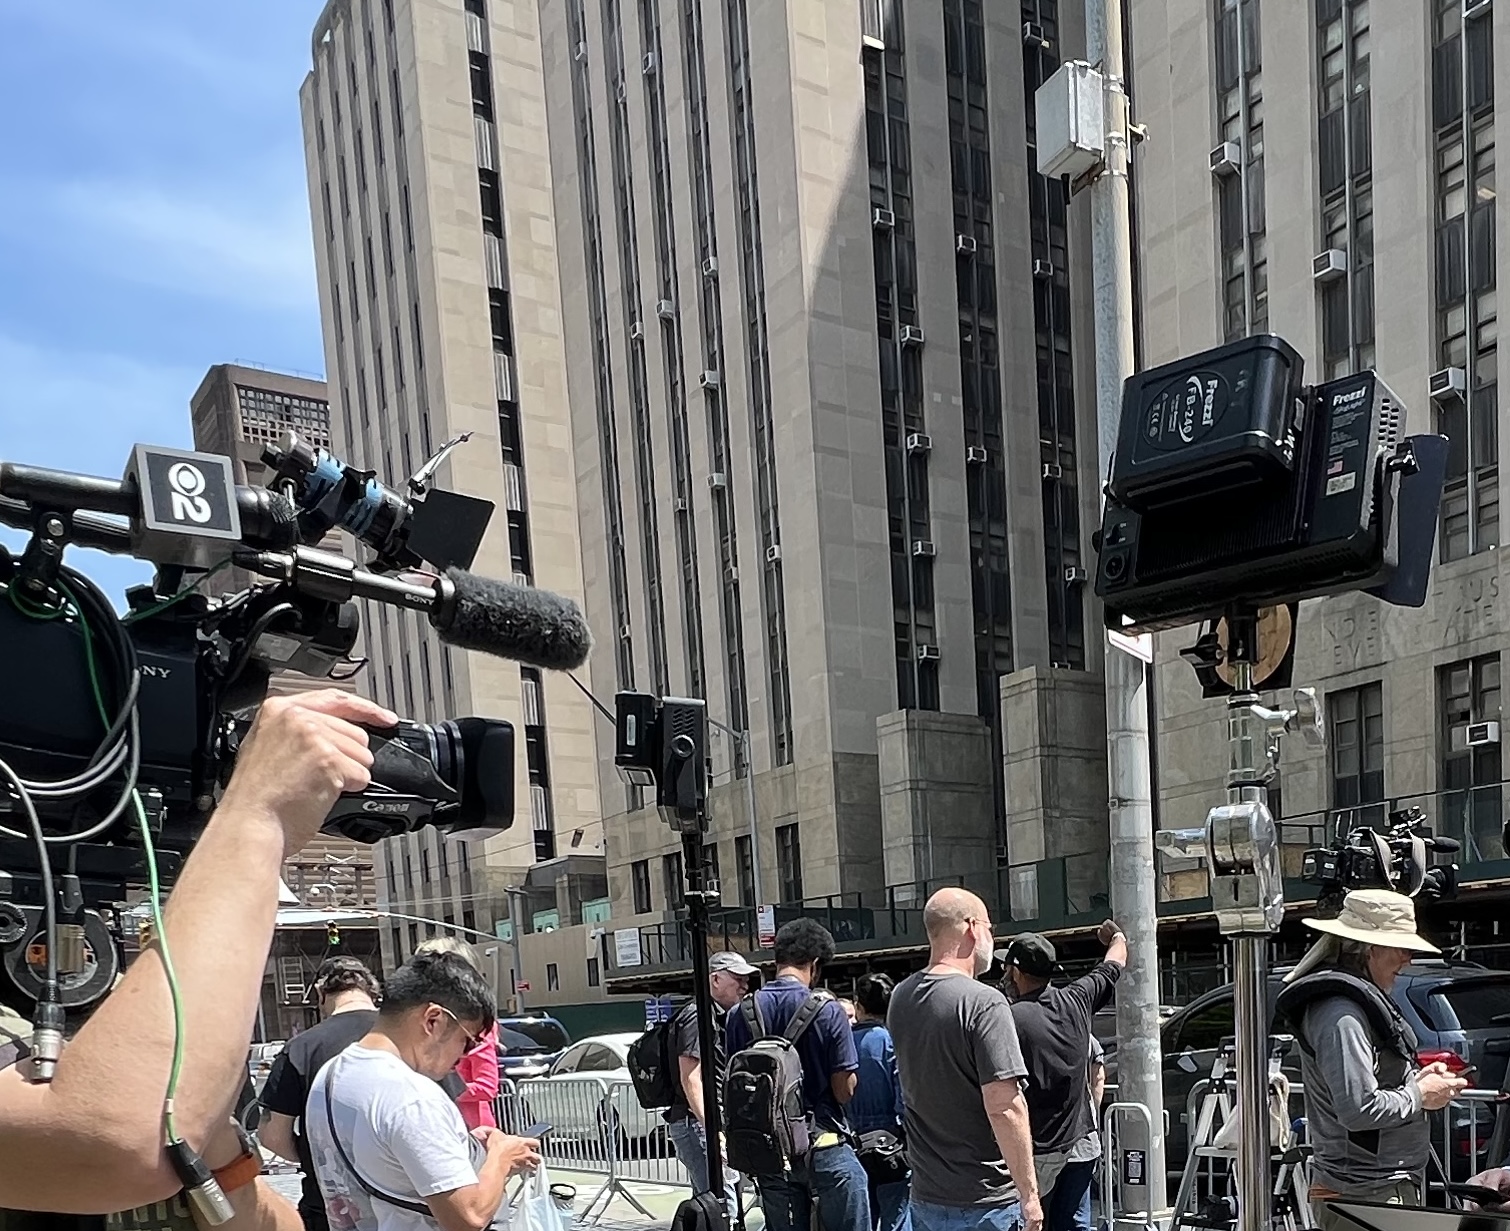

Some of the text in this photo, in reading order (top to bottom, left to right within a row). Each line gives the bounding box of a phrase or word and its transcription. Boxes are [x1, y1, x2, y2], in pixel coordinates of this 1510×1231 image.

[1183, 386, 1197, 434] FB-240
[171, 491, 211, 523] 2
[405, 593, 434, 606] SONY
[142, 665, 171, 678] NY
[362, 800, 410, 812] Canon
